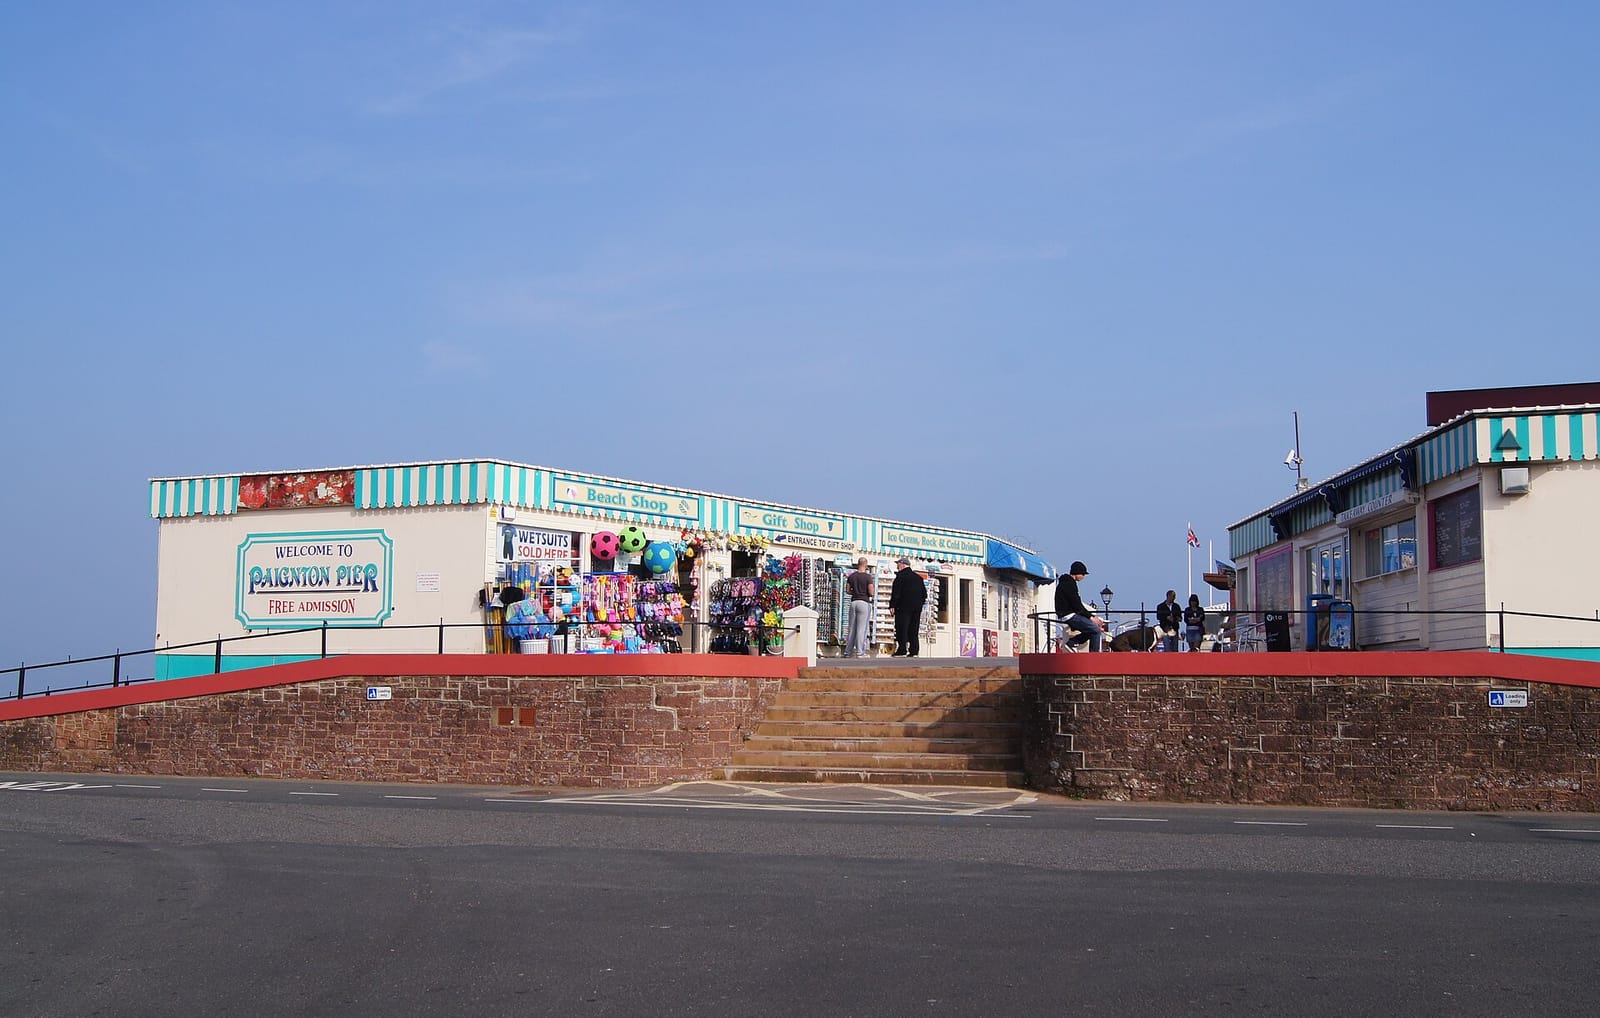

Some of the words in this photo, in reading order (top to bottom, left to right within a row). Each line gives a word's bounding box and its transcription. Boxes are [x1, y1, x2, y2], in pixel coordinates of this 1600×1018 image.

[586, 488, 627, 508] Beach
[631, 495, 669, 514] Shop
[762, 513, 788, 528] Gift
[794, 517, 820, 534] Shop
[518, 530, 569, 548] WETSUITS
[787, 535, 818, 547] ENTRANCE
[818, 539, 827, 548] TO
[827, 540, 840, 550] GIFT
[840, 542, 856, 552] SHOP
[887, 532, 898, 542] Ice
[898, 533, 920, 546] Cream,
[921, 537, 937, 547] Rock
[938, 539, 946, 548] &
[946, 540, 961, 550] Cold
[961, 541, 980, 552] Drinks
[275, 544, 334, 560] WELCOME
[337, 543, 354, 558] TO
[517, 545, 543, 560] SOLD
[544, 548, 569, 559] HERE
[248, 565, 331, 595] PAIGNTON
[335, 562, 379, 594] PIER
[268, 599, 296, 615] FREE
[297, 598, 356, 614] ADMISSION
